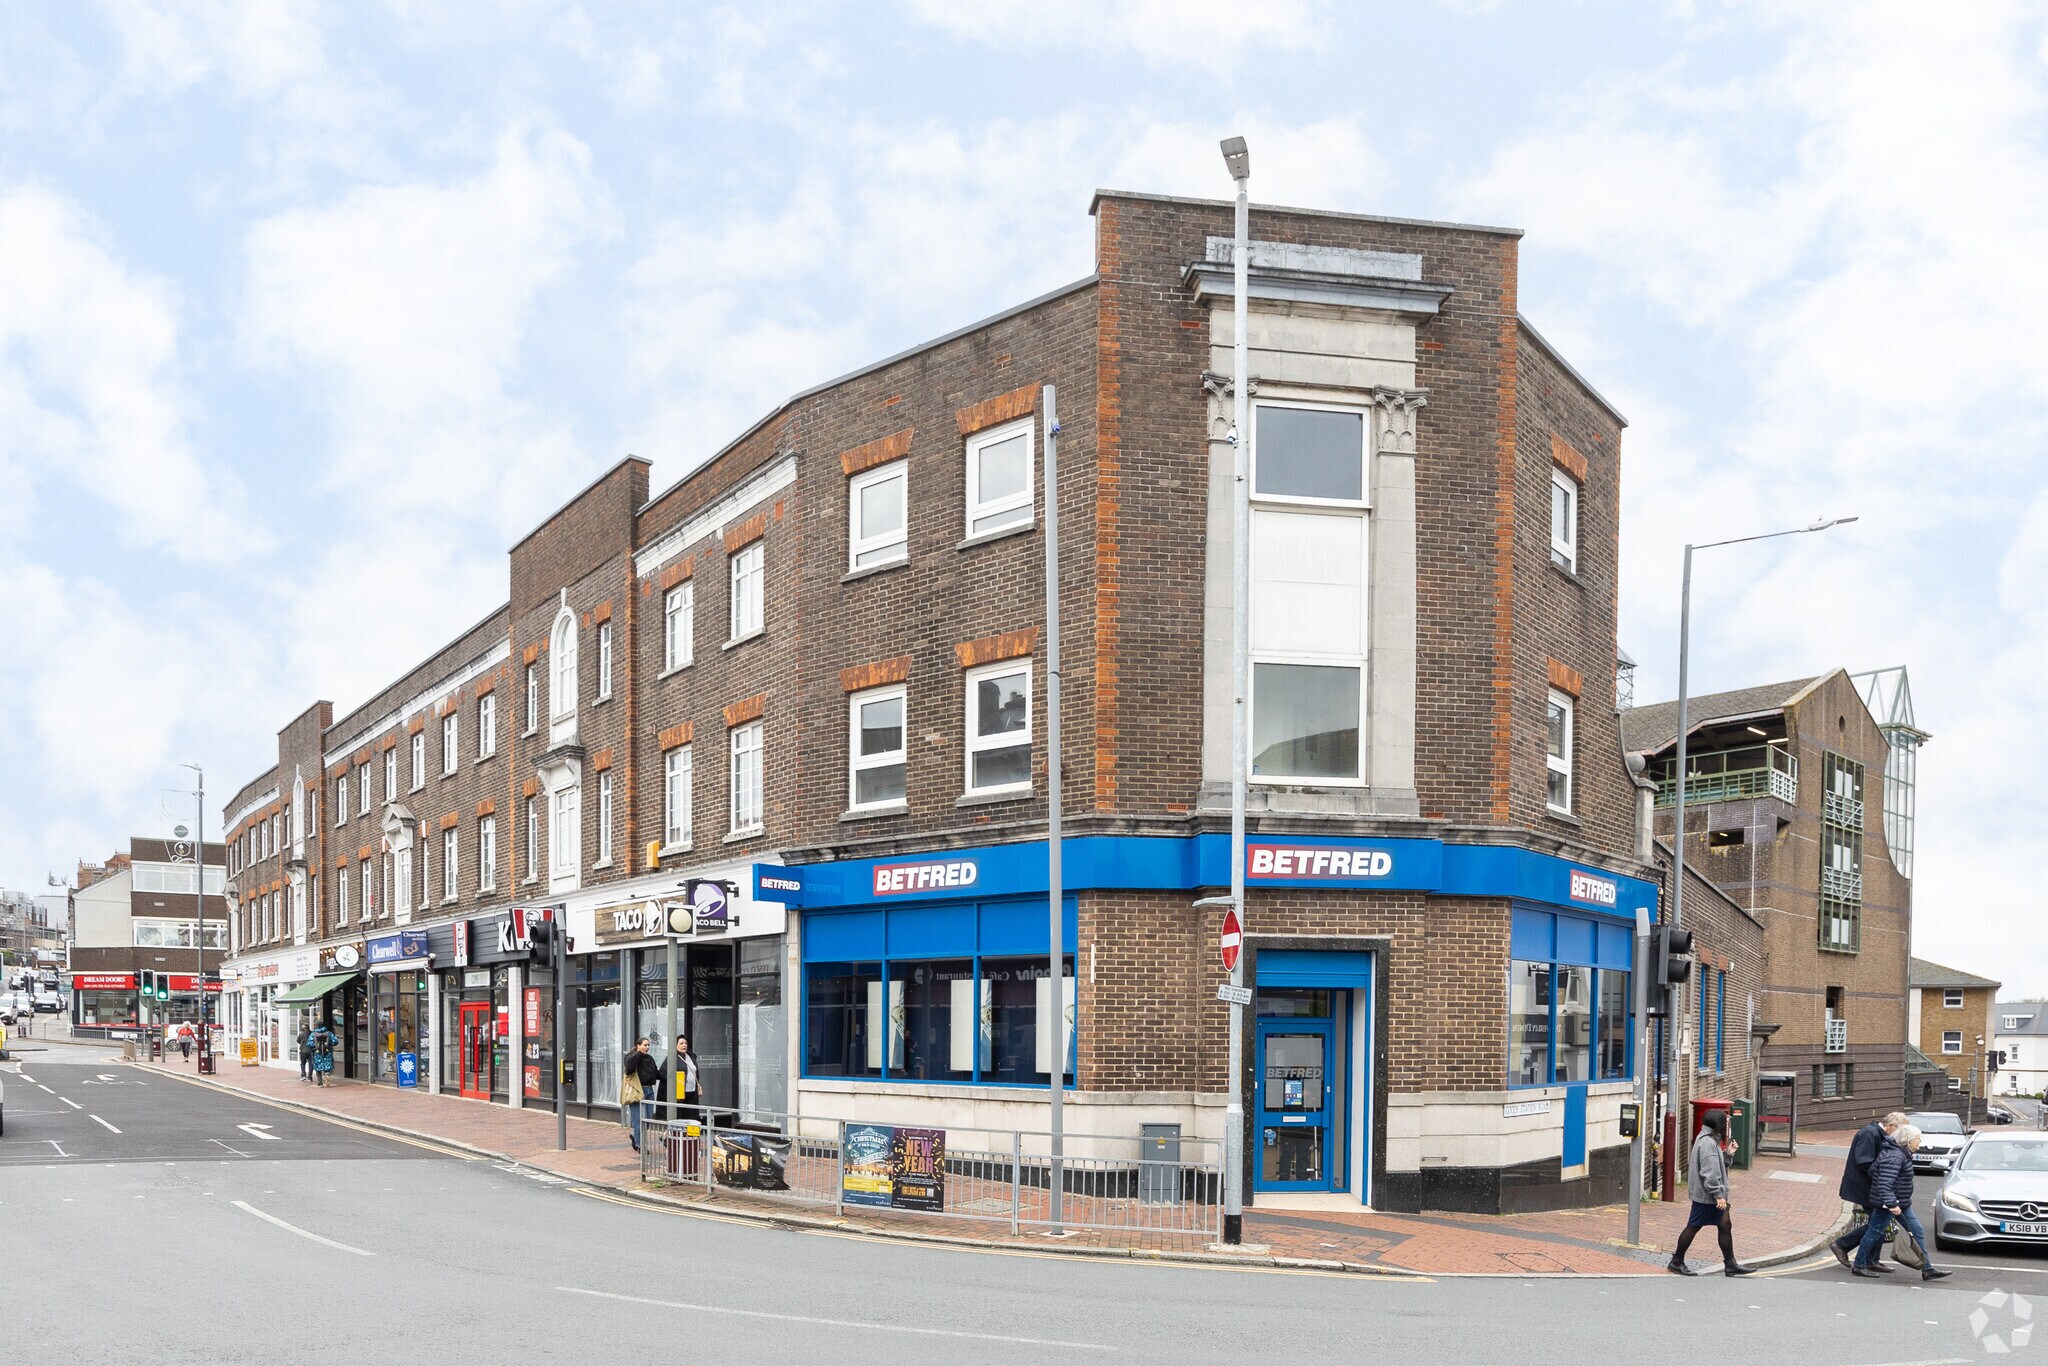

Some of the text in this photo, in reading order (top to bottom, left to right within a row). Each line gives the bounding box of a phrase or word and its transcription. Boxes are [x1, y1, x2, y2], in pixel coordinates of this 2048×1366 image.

[1251, 849, 1392, 876] BETFRED
[761, 877, 800, 891] BETFRED
[876, 862, 977, 892] BETFRED
[1571, 874, 1616, 904] BETFRED
[612, 909, 642, 932] TACO
[710, 919, 726, 927] BELL
[372, 941, 397, 959] Clearwell
[1266, 1067, 1322, 1078] BETFRED
[905, 1139, 933, 1157] NEW
[903, 1156, 934, 1173] YEAR
[2009, 1223, 2032, 1233] KS18
